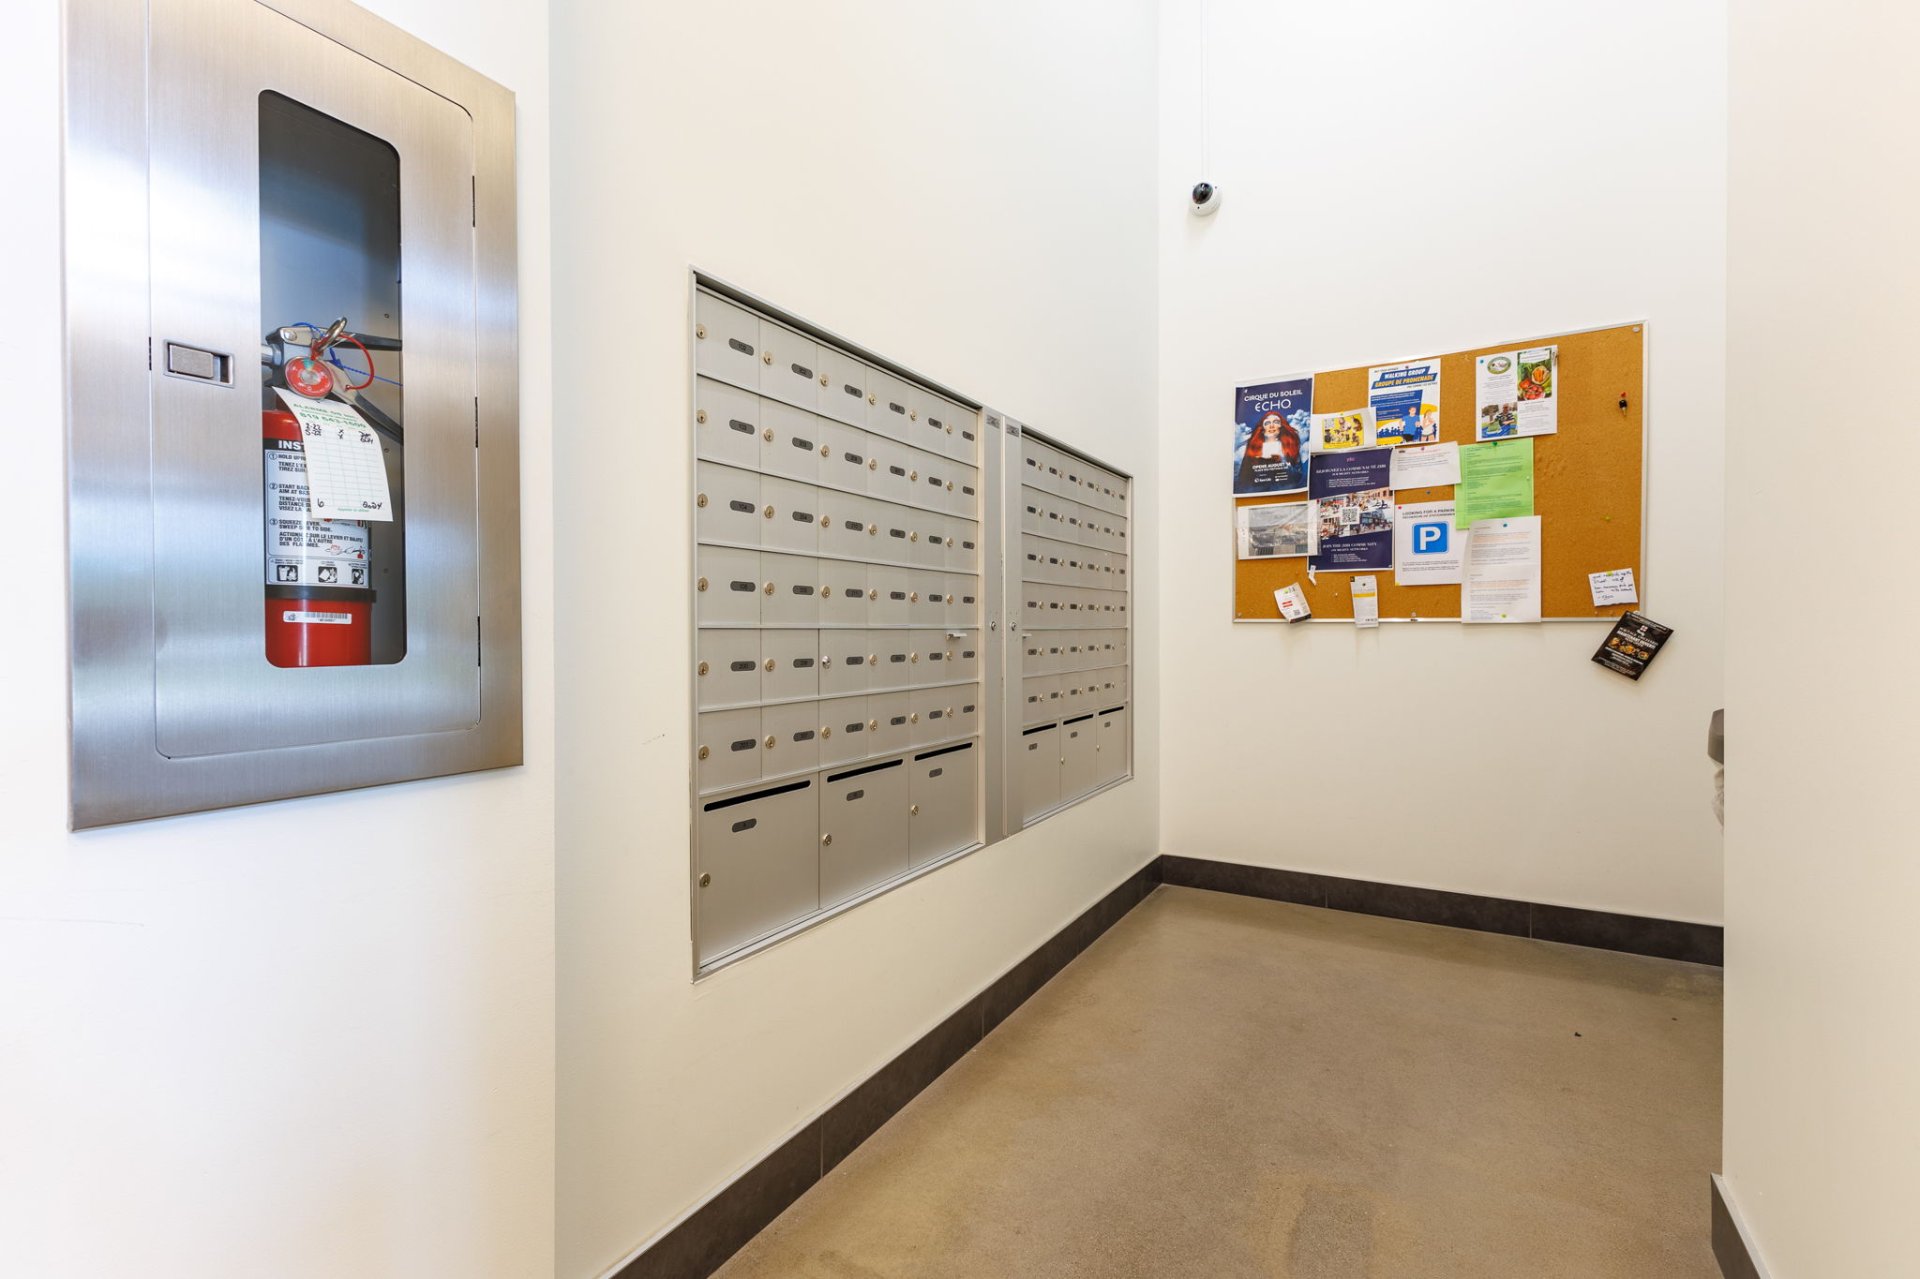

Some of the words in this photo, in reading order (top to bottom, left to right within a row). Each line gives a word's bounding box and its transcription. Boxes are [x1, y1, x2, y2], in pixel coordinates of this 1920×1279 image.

[1244, 393, 1268, 401] CIRQUE
[1255, 398, 1291, 412] ECHO
[278, 440, 304, 450] INS
[1420, 527, 1441, 550] P
